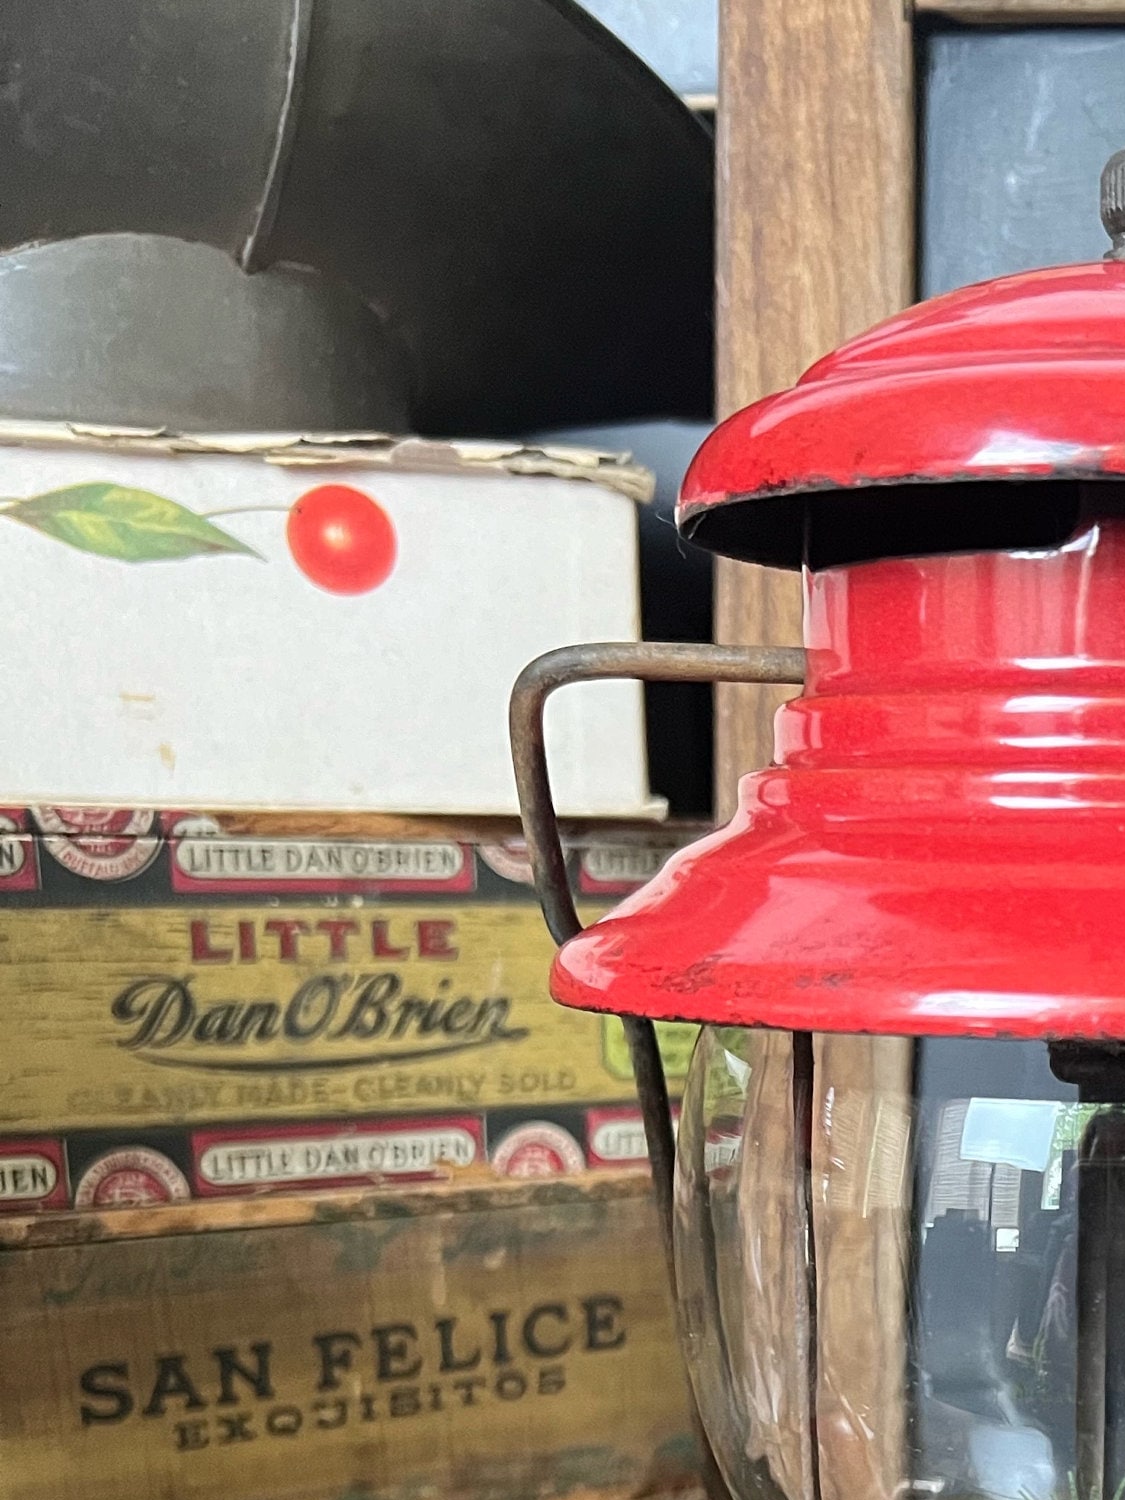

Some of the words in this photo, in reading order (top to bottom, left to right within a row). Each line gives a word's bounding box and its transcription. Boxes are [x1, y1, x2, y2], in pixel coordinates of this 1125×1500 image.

[188, 845, 276, 873] LITTLE
[284, 846, 343, 874] DAN
[350, 846, 457, 874] O'BRIEN
[190, 919, 460, 964] LITTLE
[500, 1071, 577, 1094] SOLD
[211, 1149, 291, 1181] LITTLE
[304, 1146, 362, 1176] DAN
[80, 1341, 274, 1427] SAN
[313, 1294, 628, 1391] FELICE
